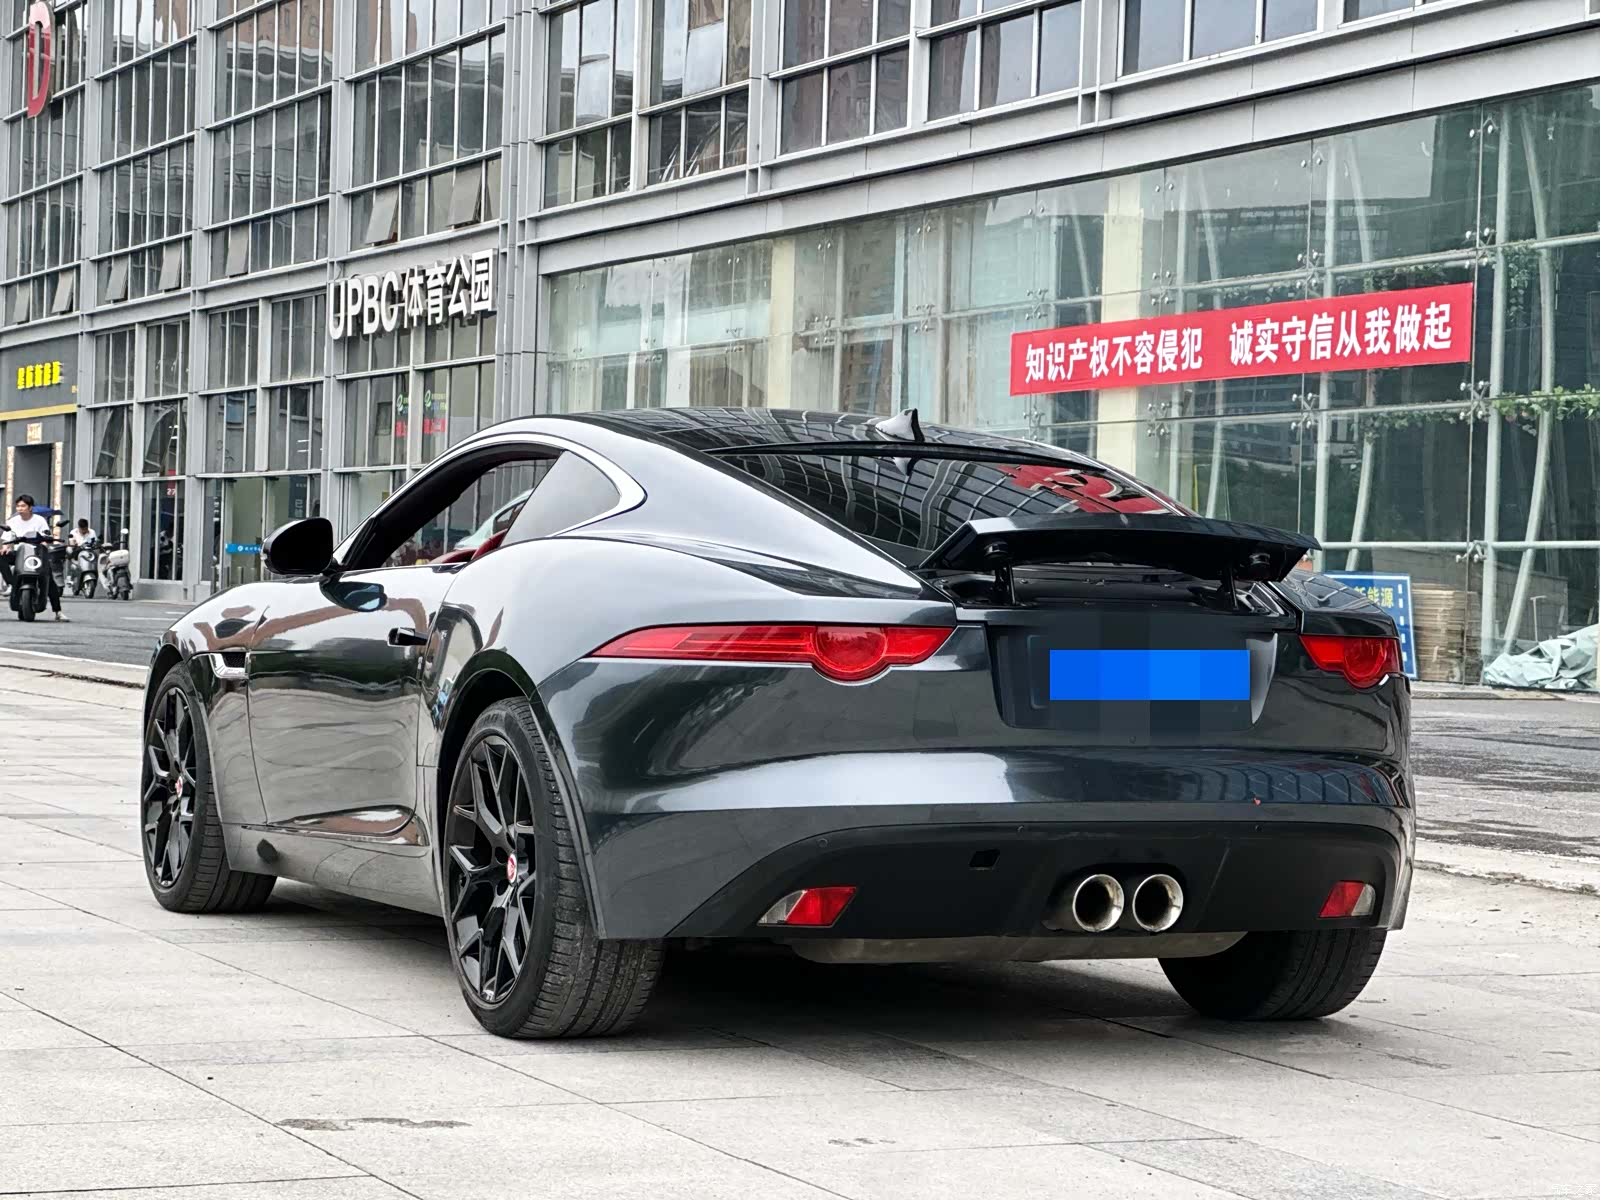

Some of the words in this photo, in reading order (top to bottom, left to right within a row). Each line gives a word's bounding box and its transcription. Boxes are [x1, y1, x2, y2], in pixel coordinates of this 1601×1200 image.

[27, 1, 51, 119] D
[1025, 327, 1203, 384] 知识产权不容侵犯
[1229, 301, 1452, 366] 诚实守信从我做起
